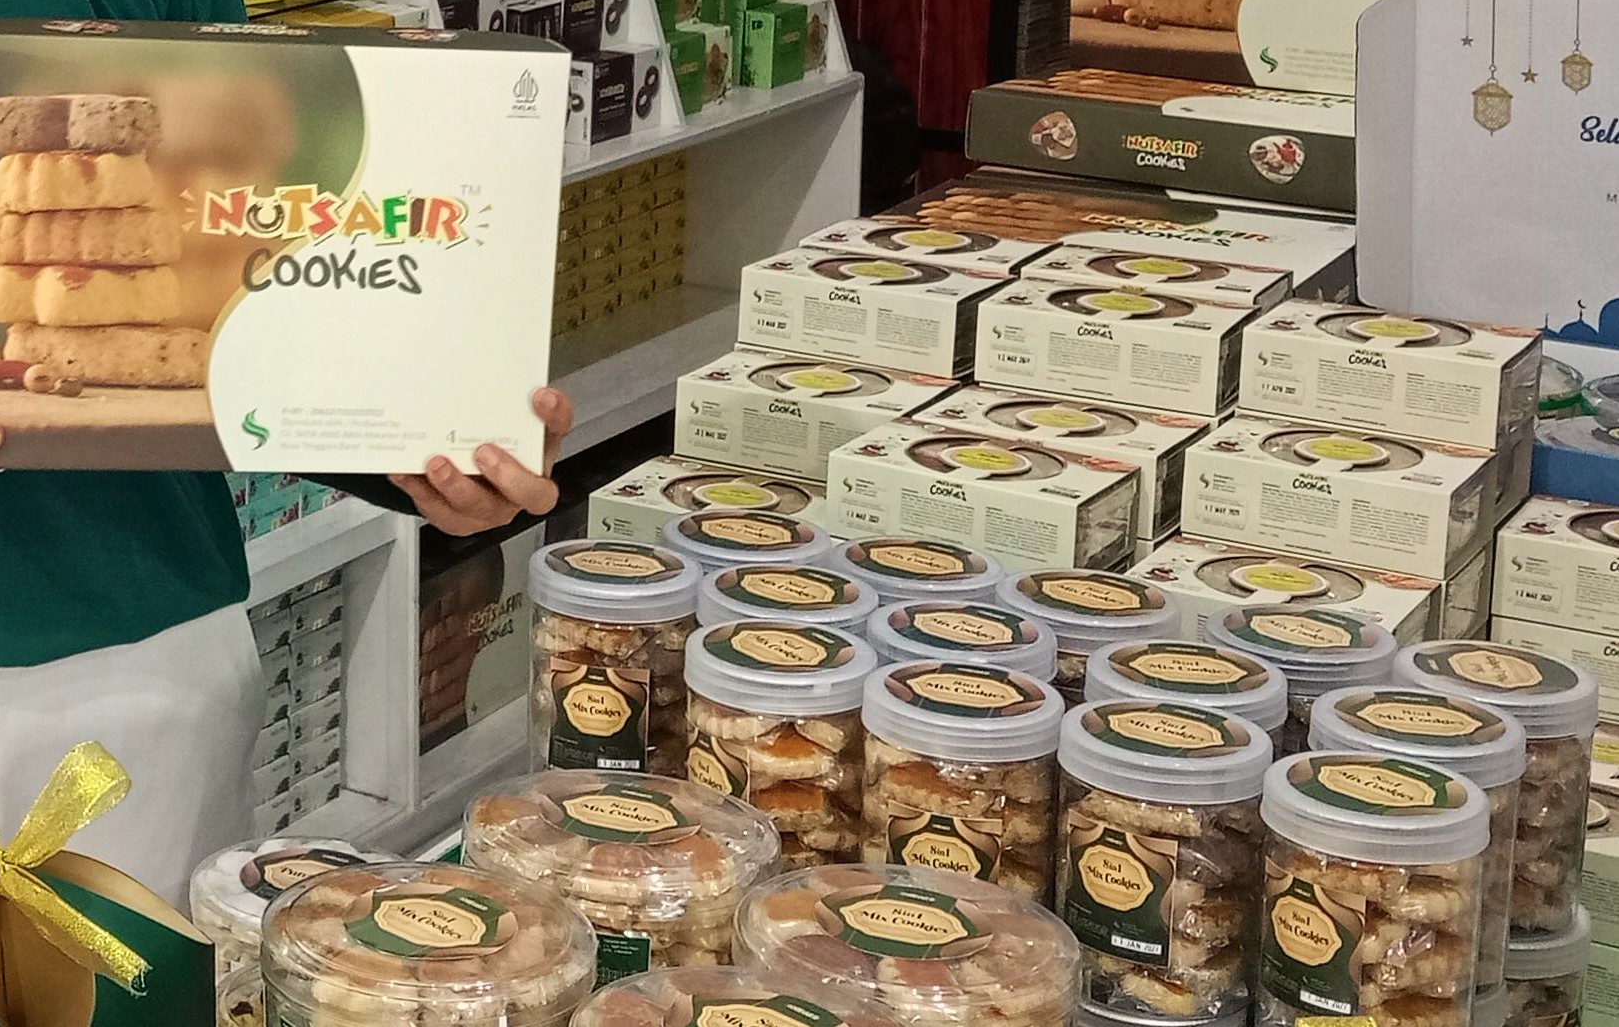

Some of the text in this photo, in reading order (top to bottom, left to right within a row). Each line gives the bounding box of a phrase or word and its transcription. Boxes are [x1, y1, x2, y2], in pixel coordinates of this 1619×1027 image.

[1126, 133, 1200, 159] NUTSAFIR
[1136, 152, 1187, 171] COOKIES
[201, 183, 471, 249] NUTSAFIR
[242, 248, 424, 296] COOKIES
[571, 701, 622, 718] Mix Cookies
[911, 852, 970, 873] Mix Cookies
[930, 844, 950, 857] 8in1
[1086, 864, 1142, 892] Mix Cookies
[1102, 858, 1123, 874] 8in1
[418, 912, 464, 940] Cookies
[860, 909, 949, 935] Mix Cookies
[1277, 915, 1331, 947] Mix Cookies
[1291, 910, 1312, 926] 8in1
